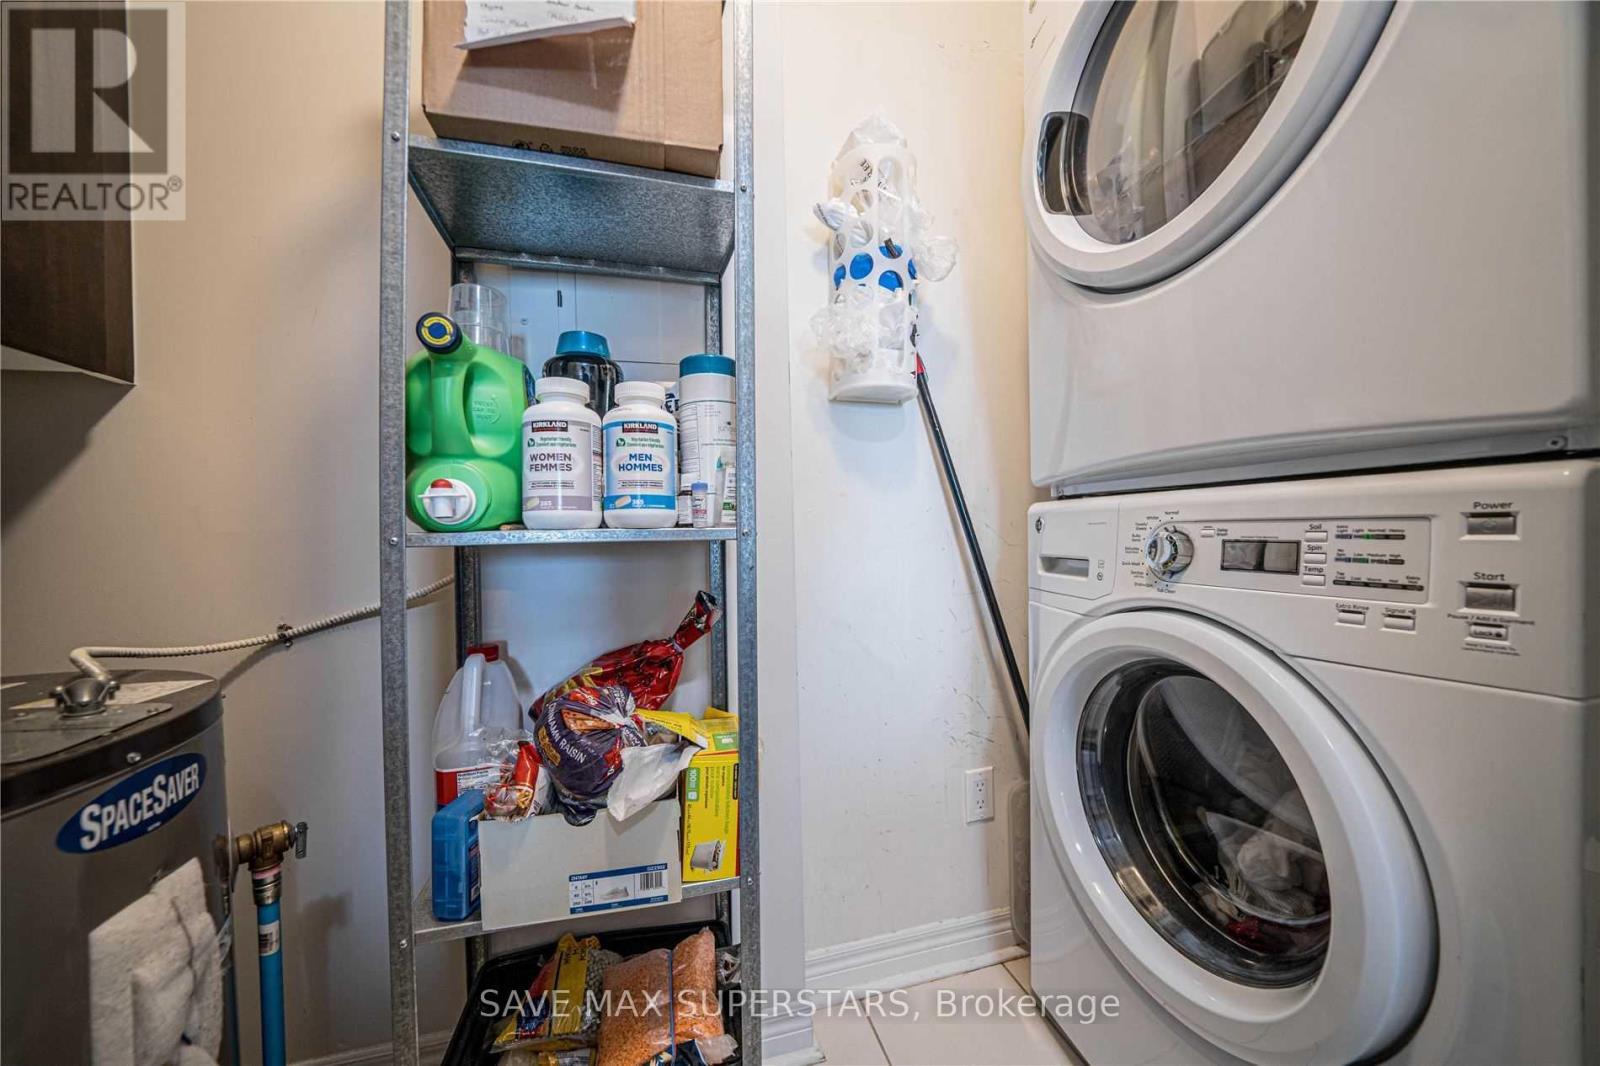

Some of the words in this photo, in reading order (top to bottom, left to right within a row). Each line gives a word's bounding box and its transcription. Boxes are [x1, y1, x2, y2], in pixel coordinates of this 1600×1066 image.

[532, 420, 567, 429] KIRKLAND
[623, 422, 658, 430] KIRKLAND
[529, 453, 572, 462] WOMEN
[628, 453, 653, 462] MEN
[529, 463, 573, 472] FEMMES
[618, 463, 664, 472] HOMMES
[1472, 501, 1513, 510] Power
[1306, 544, 1323, 552] Spin
[1303, 565, 1324, 573] Temp
[1473, 571, 1507, 581] Start
[1353, 603, 1370, 611] Rinse
[559, 738, 587, 764] RAISIN
